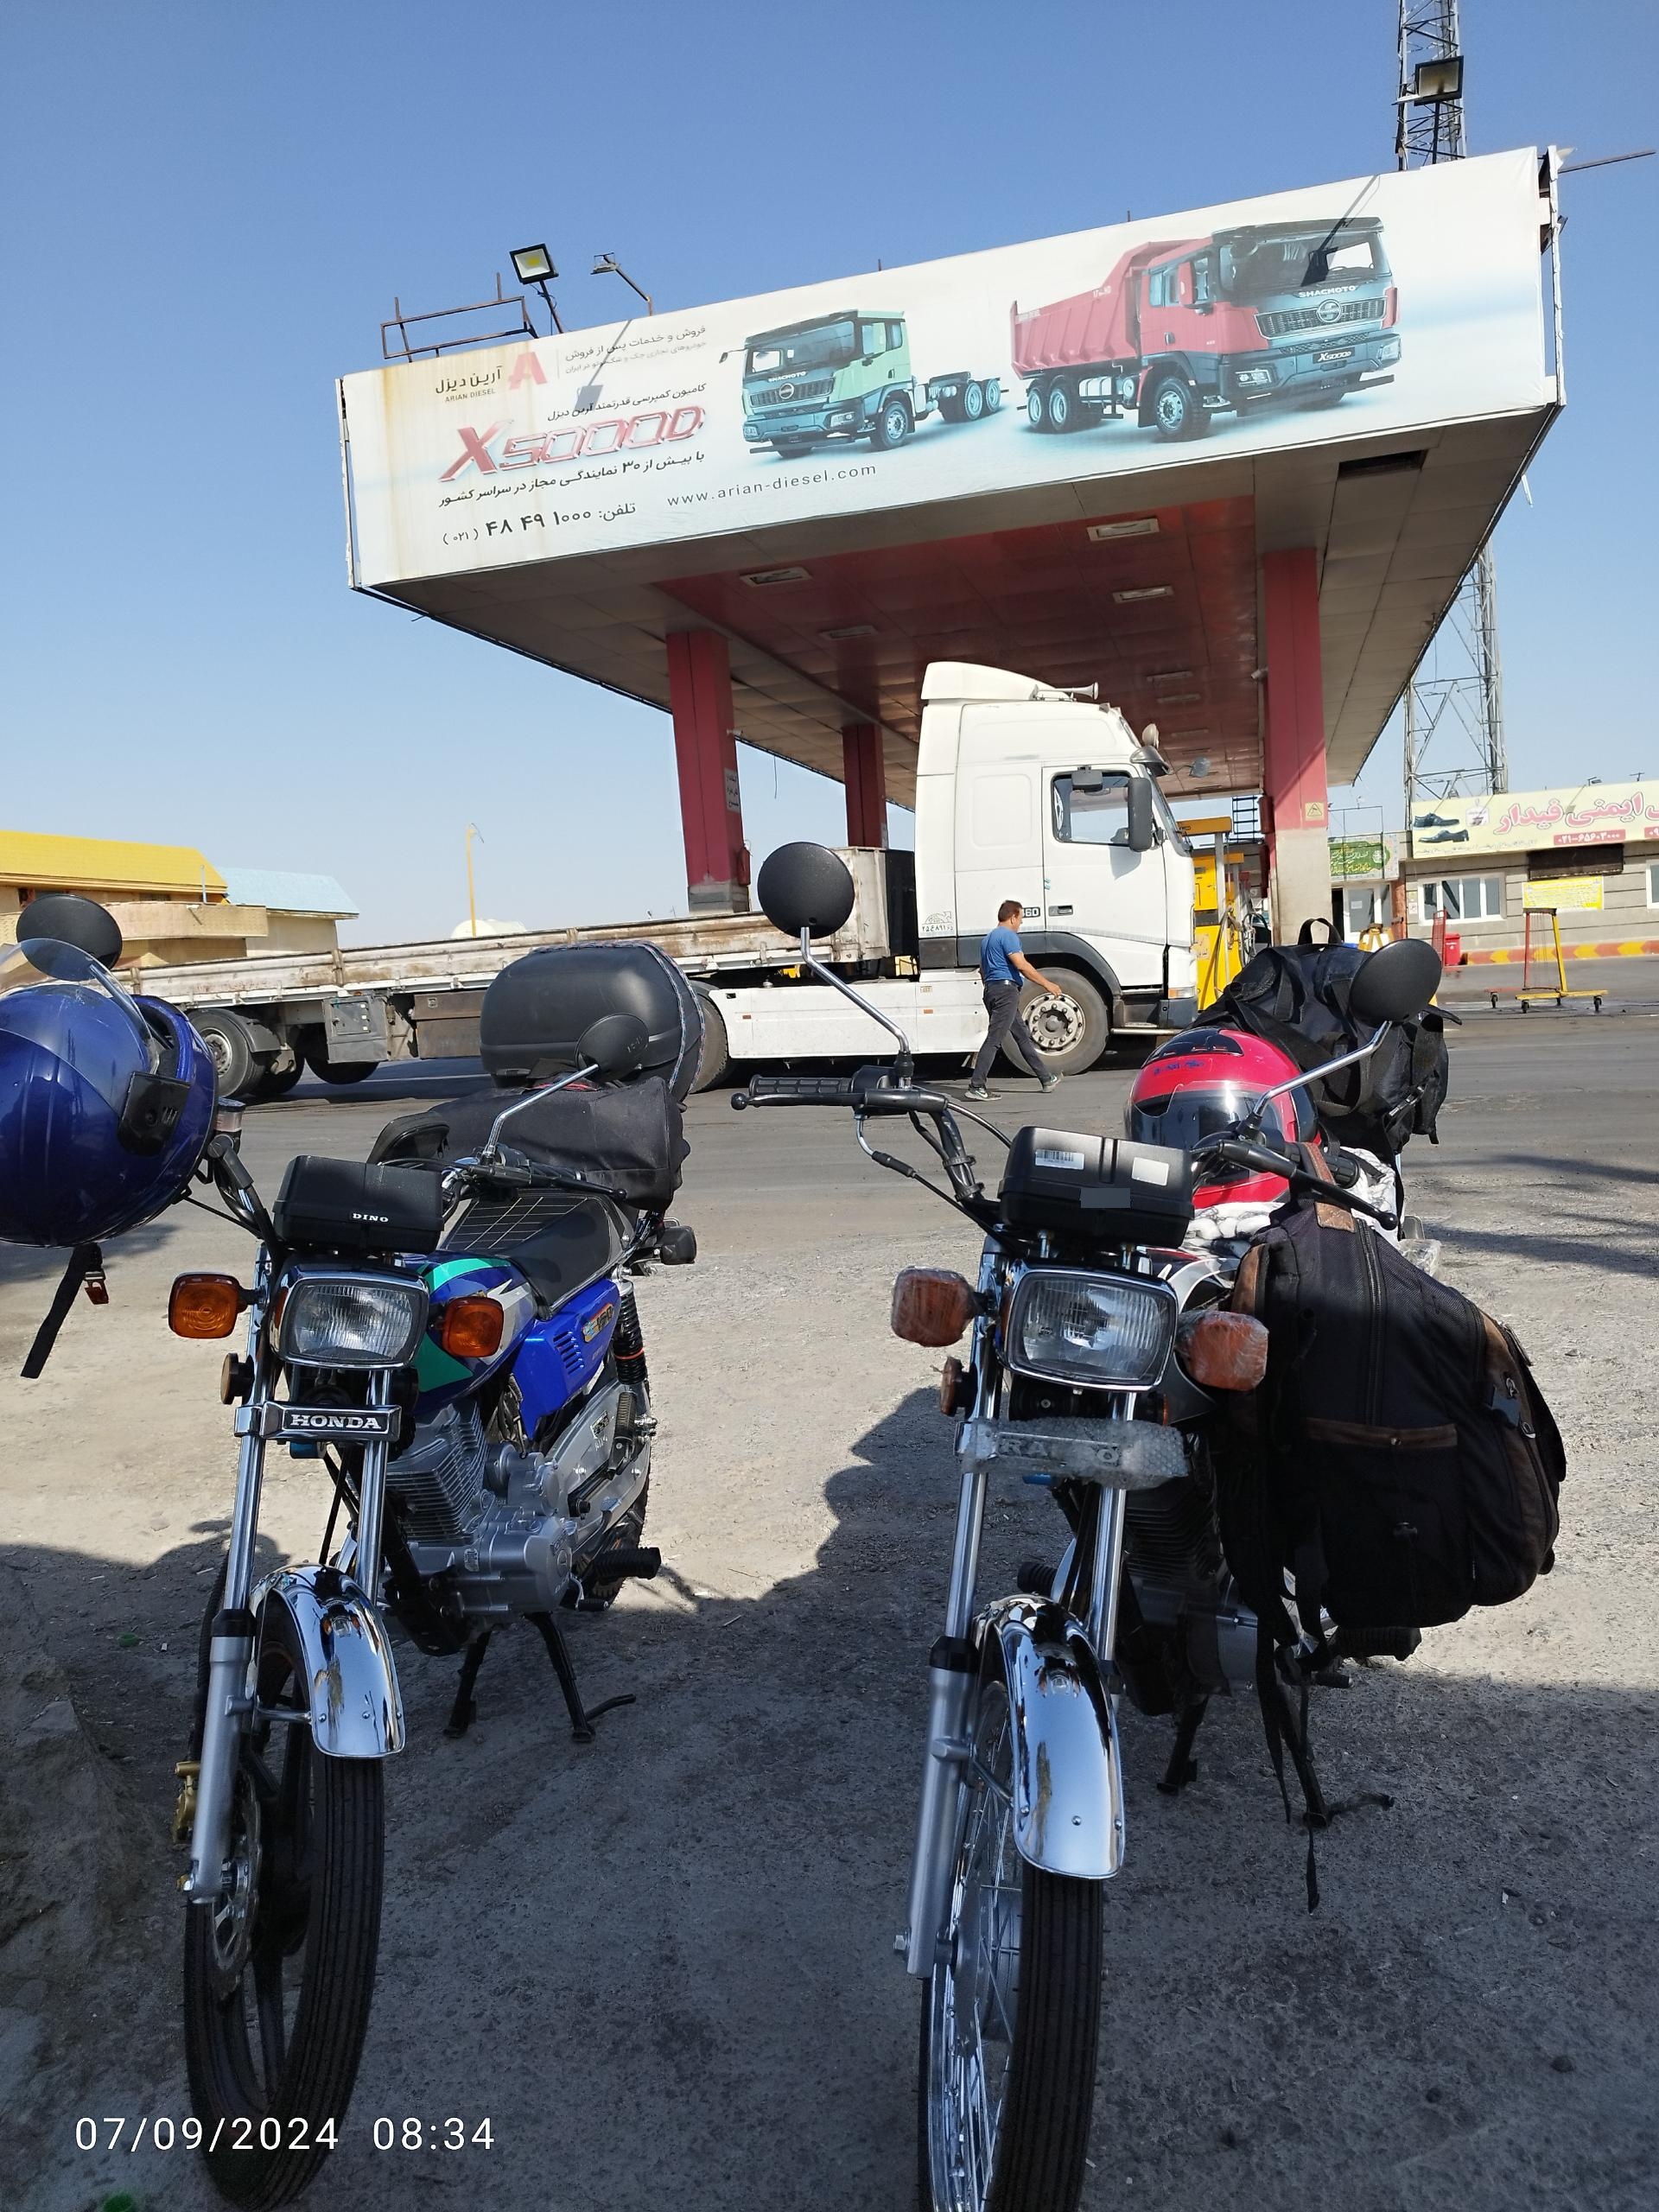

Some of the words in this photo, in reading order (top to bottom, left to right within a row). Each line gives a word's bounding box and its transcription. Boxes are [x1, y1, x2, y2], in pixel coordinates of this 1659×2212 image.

[1298, 285, 1356, 298] SHACMOTO
[629, 333, 664, 346] خدمات
[667, 334, 673, 342] و
[677, 325, 706, 340] فروش
[565, 347, 594, 361] فروش
[596, 345, 604, 356] از
[470, 365, 502, 387] آرین
[435, 378, 466, 394] دیزل
[672, 383, 707, 399] کامیون
[445, 393, 467, 403] ARIAN
[470, 388, 496, 398] DIESEL
[632, 390, 671, 406] کمپرسی
[595, 397, 631, 410] قدرتمند
[547, 410, 569, 422] دیزل
[656, 454, 692, 470] بیش
[696, 450, 705, 463] با
[622, 460, 640, 474] ۳۰
[643, 459, 653, 473] از
[560, 465, 618, 486] نمایندگی
[514, 482, 526, 494] در
[529, 478, 556, 492] مجاز
[667, 464, 876, 506] www.arian-diesel.com
[439, 489, 474, 507] کشور
[476, 486, 512, 501] سراسر
[553, 511, 592, 525] ۱۰۰۰
[353, 1212, 389, 1223] DINO
[290, 1414, 381, 1429] HONDA
